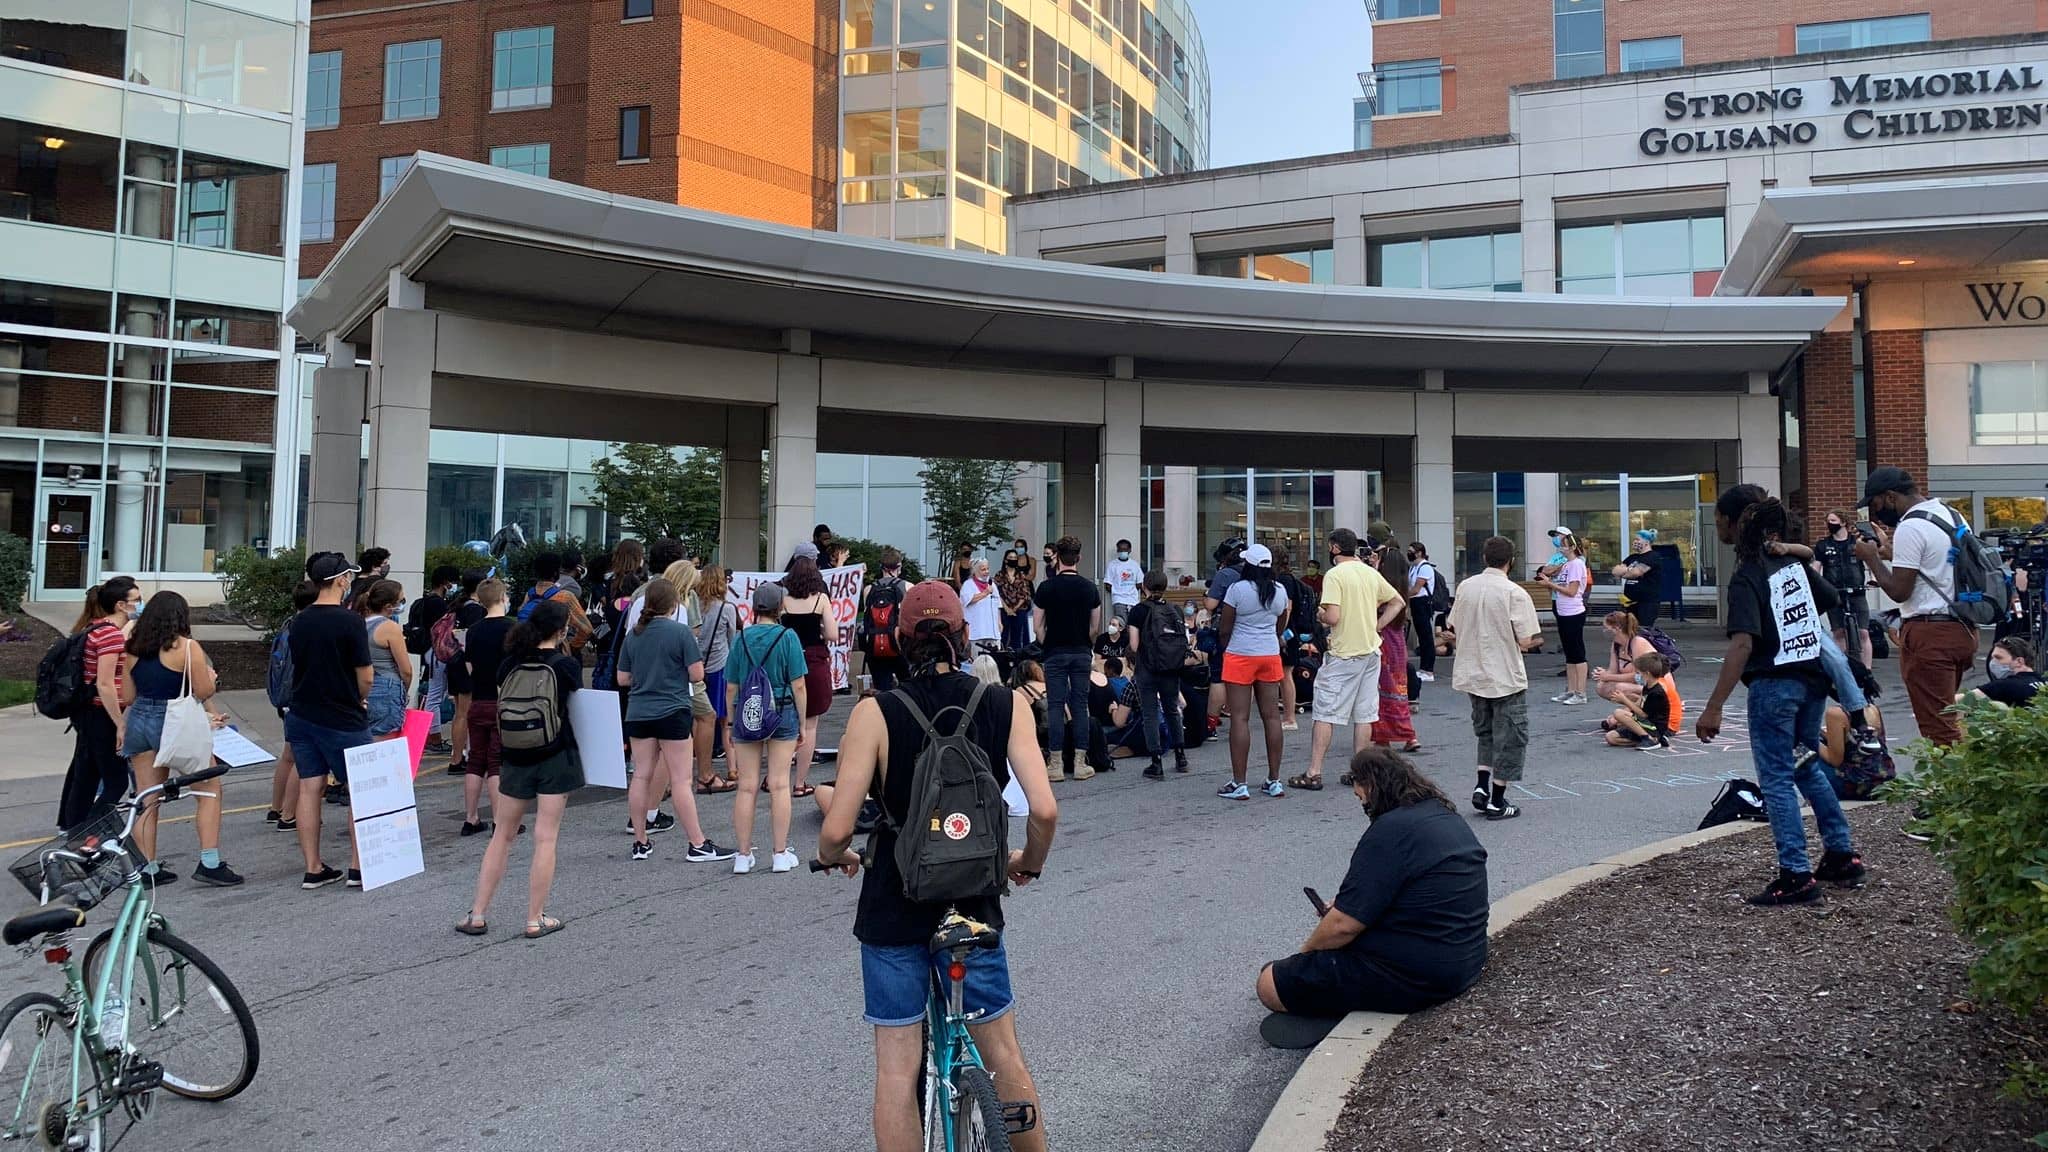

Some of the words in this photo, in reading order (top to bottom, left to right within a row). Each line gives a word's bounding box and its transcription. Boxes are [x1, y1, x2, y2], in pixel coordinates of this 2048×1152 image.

[1664, 87, 1803, 120] STRONG
[1830, 66, 2043, 106] MEMORIAL
[1639, 121, 1817, 157] GOLISANO
[830, 570, 860, 598] HAS
